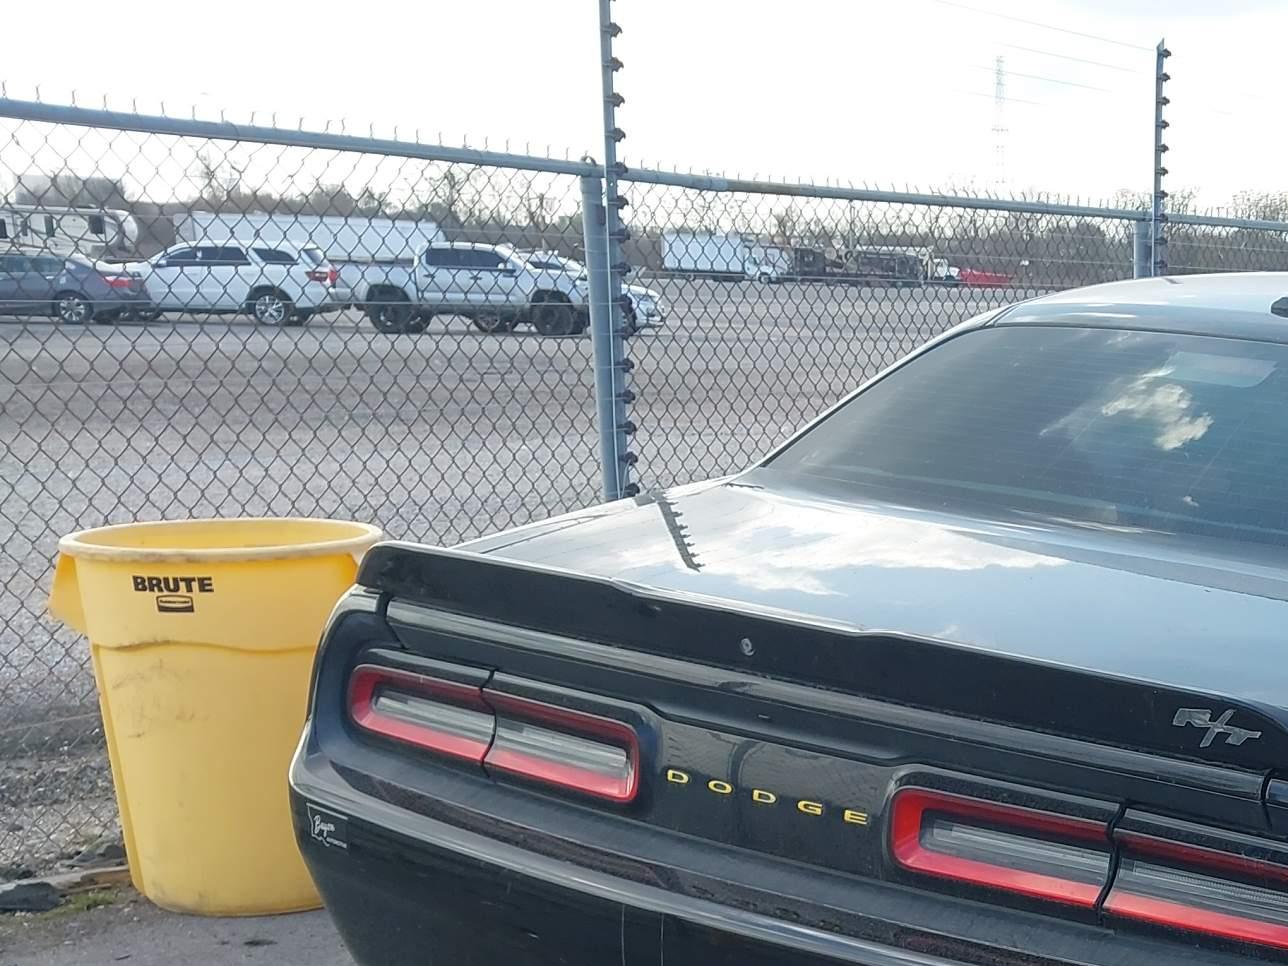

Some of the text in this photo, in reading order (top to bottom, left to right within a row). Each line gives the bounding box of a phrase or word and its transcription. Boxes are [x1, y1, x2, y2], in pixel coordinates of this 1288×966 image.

[132, 575, 214, 593] BRUTE
[1172, 707, 1262, 748] R/T
[667, 768, 868, 825] DODGE
